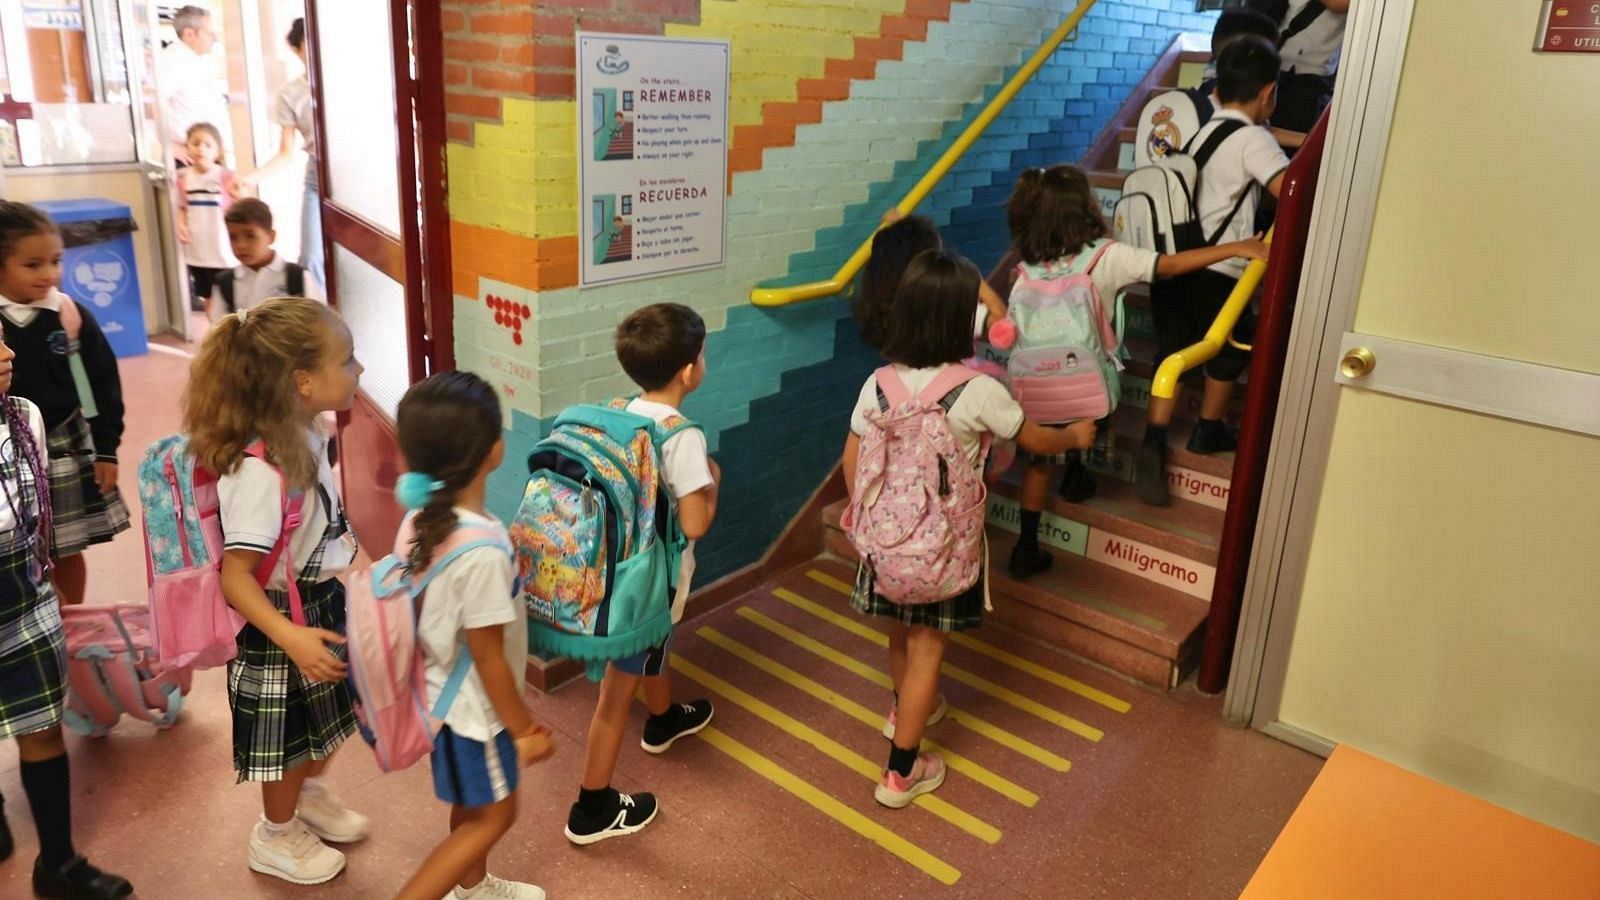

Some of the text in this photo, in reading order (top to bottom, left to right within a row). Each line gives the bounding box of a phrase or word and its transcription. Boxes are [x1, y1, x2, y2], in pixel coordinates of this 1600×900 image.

[640, 89, 712, 102] REMEMBER
[640, 187, 707, 203] RECUERDA
[1104, 538, 1199, 585] Miligramo
